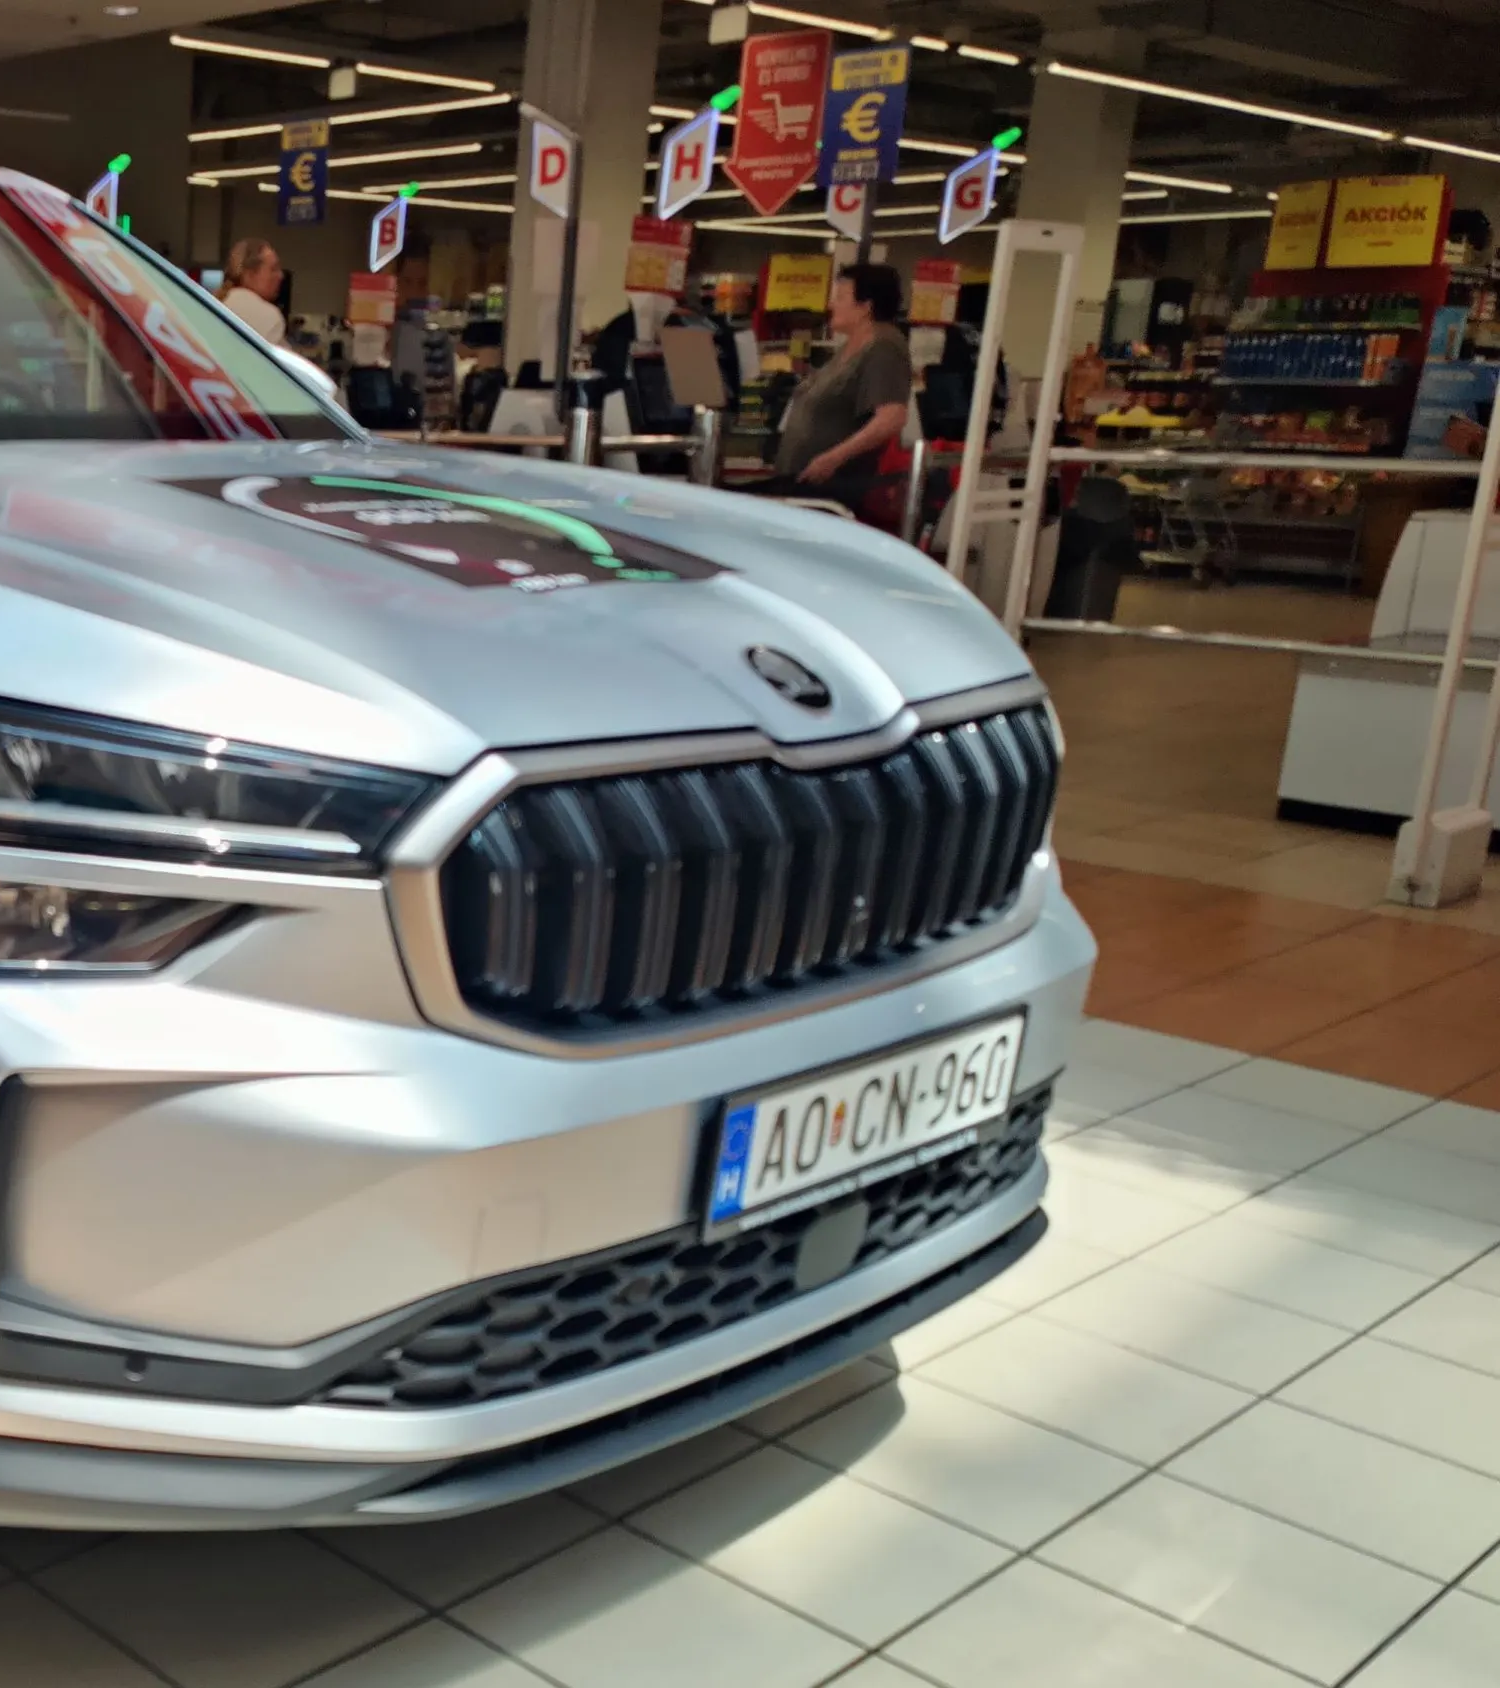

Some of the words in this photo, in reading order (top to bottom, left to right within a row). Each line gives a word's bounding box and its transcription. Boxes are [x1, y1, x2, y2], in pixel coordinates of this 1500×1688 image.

[539, 146, 567, 186] D
[673, 143, 704, 182] H
[835, 184, 861, 213] C
[955, 176, 983, 210] G
[1344, 202, 1428, 223] AKCIÓK
[379, 218, 398, 245] B
[851, 1035, 1010, 1157] CN-960
[719, 1169, 741, 1202] H
